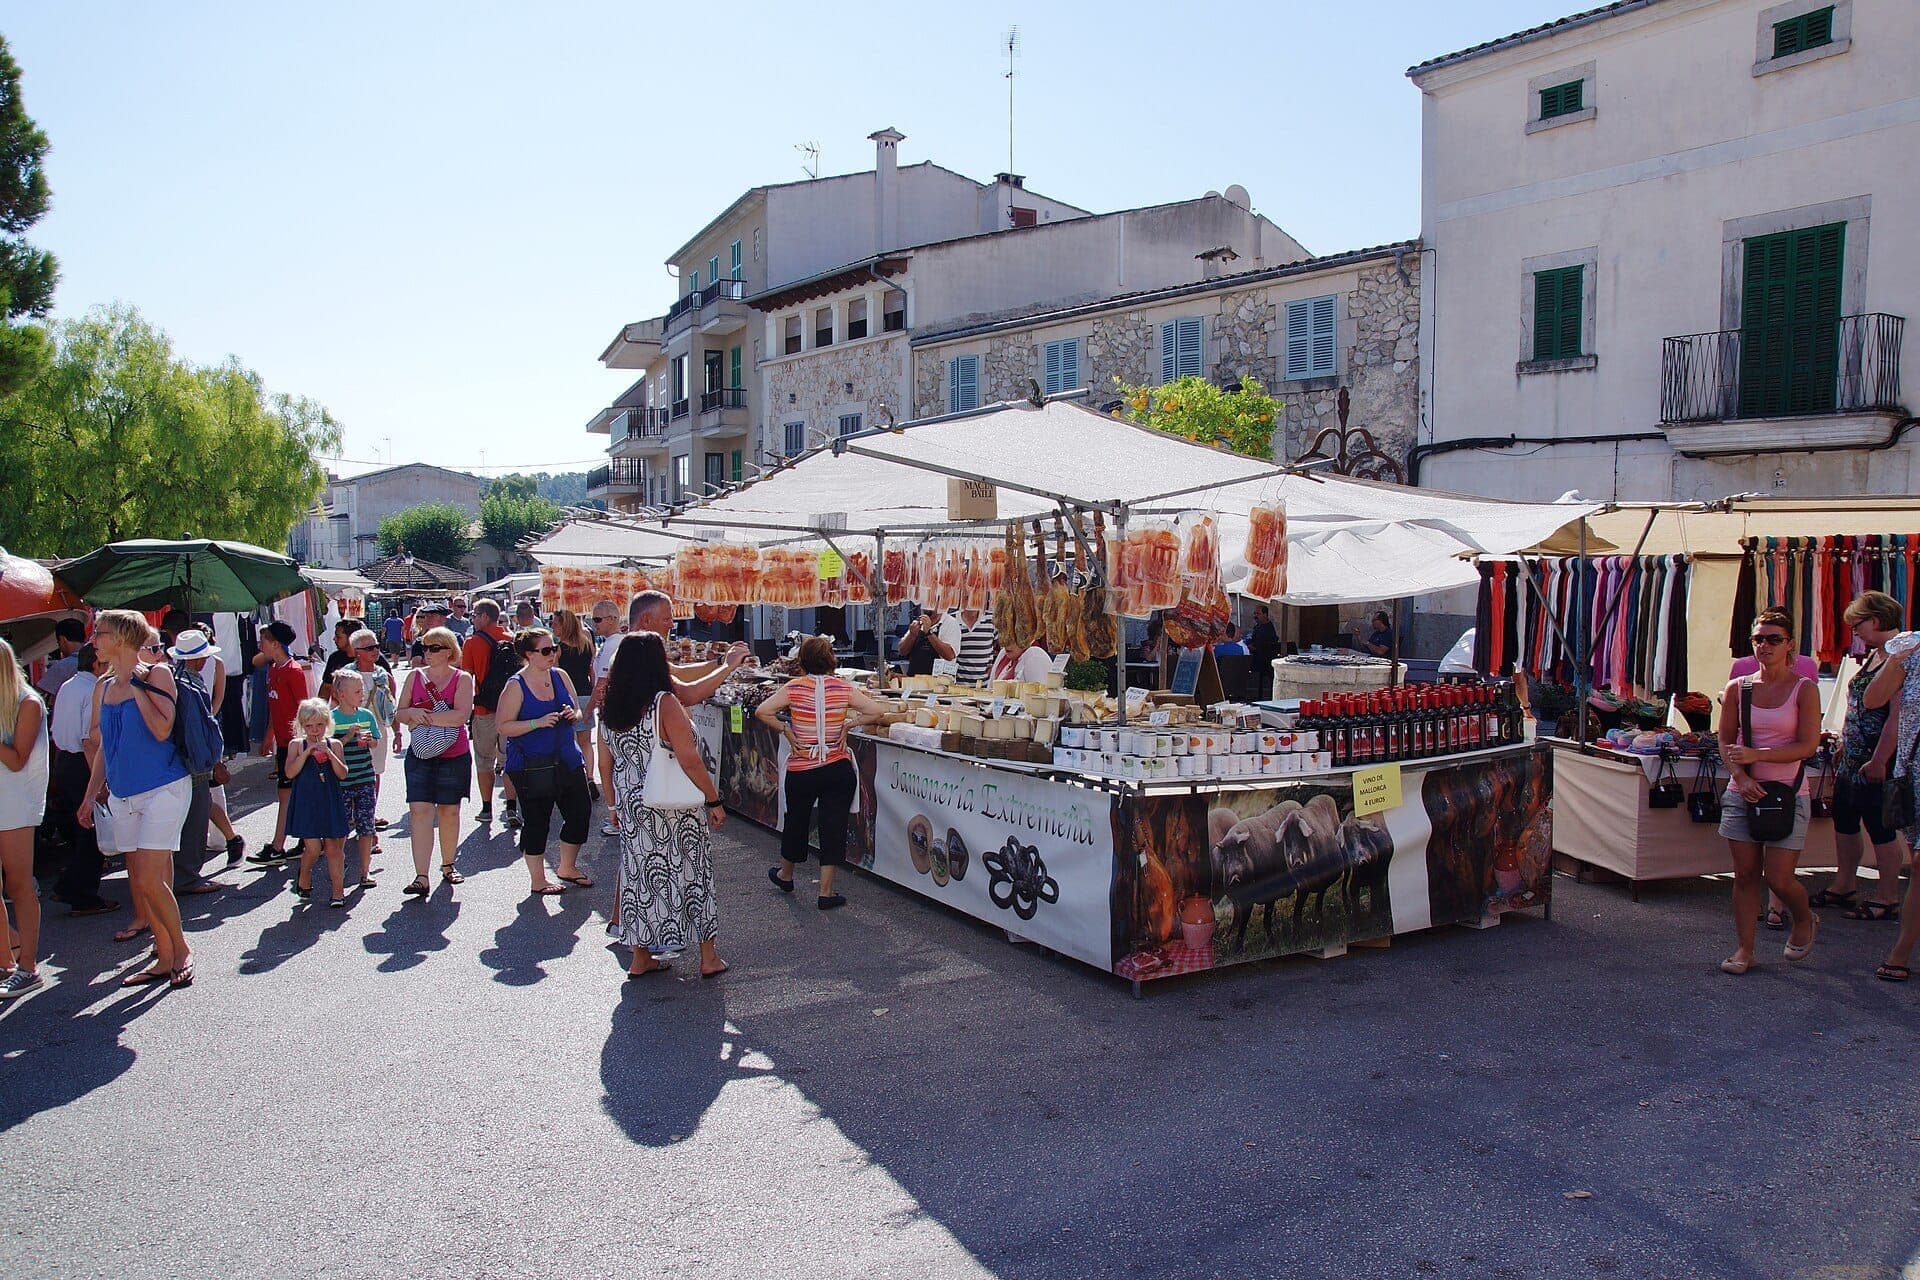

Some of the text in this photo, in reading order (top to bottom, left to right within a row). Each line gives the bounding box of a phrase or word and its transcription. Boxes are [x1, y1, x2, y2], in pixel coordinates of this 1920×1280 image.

[1363, 776, 1376, 784] VINO
[1360, 784, 1387, 795] MALLORCA
[890, 761, 1095, 846] Jamonería Extremeña
[1369, 796, 1386, 805] EUROS
